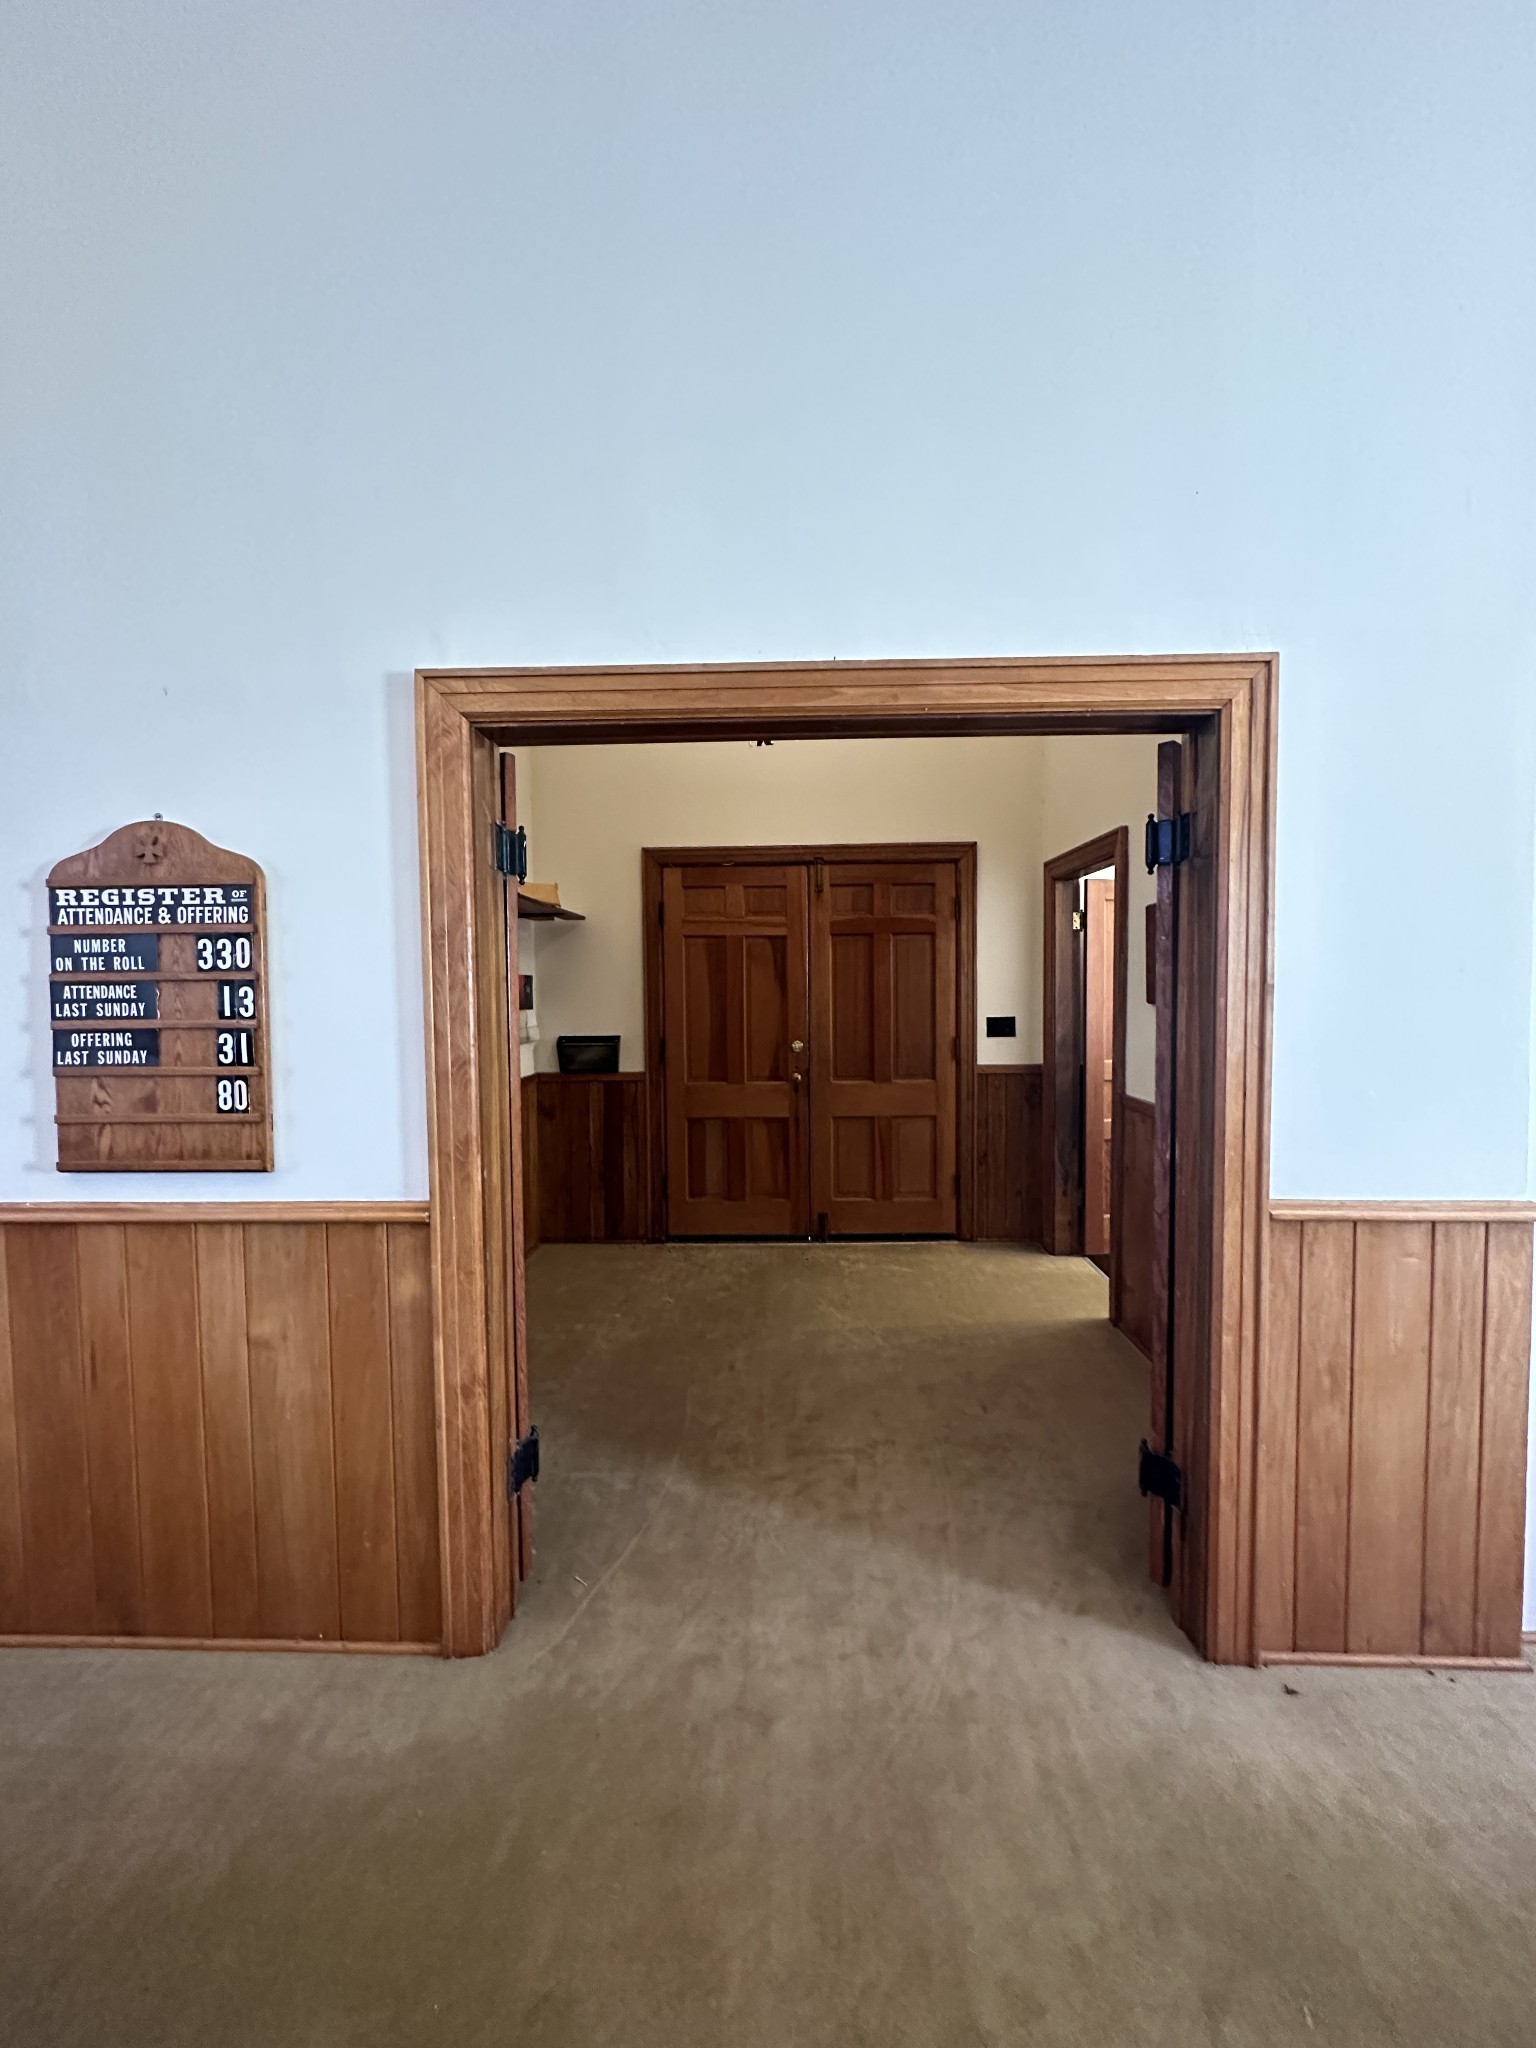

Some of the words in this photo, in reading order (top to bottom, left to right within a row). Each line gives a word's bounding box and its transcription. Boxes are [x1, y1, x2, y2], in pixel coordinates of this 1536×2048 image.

[56, 888, 225, 906] REGISTER
[232, 890, 247, 898] OF
[58, 907, 152, 925] ATTENDANCE
[158, 908, 171, 924] &
[177, 906, 248, 924] OFFERING
[74, 939, 126, 953] NUMBER
[197, 938, 250, 970] 330
[56, 957, 72, 971] ON
[81, 957, 106, 971] THE
[113, 957, 145, 970] ROLL
[63, 986, 137, 1000] ATTENDANCE
[223, 986, 254, 1017] 13
[56, 1003, 87, 1017] LAST
[96, 1003, 145, 1017] SUNDAY
[71, 1033, 132, 1047] OFFERING
[218, 1033, 248, 1064] 31
[57, 1051, 89, 1064] LAST
[98, 1050, 147, 1064] SUNDAY
[218, 1080, 247, 1110] 80
